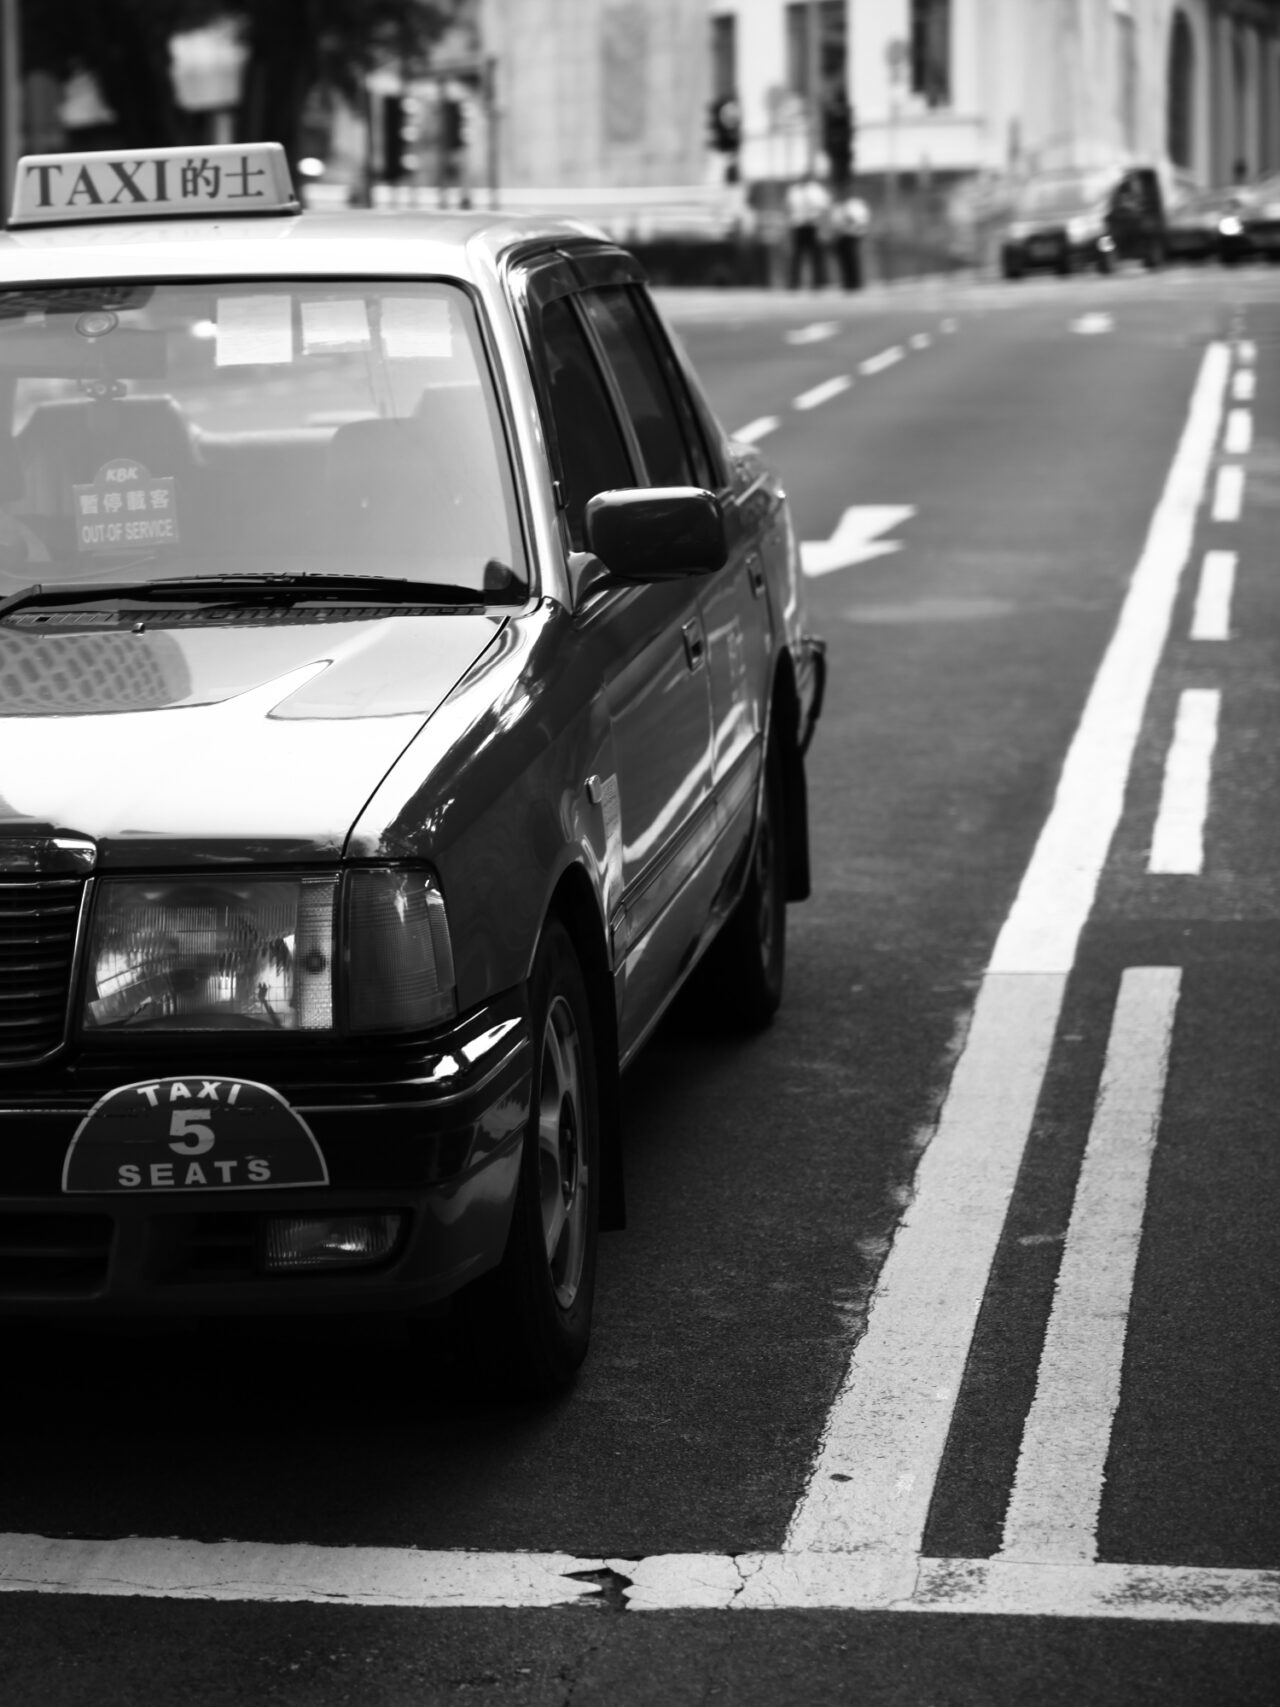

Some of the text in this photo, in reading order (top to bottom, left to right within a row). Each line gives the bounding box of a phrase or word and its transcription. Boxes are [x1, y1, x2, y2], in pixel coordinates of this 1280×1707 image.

[26, 156, 265, 207] TAXI 的士
[106, 467, 138, 482] KBK
[80, 489, 170, 514] 暫停載客
[82, 518, 173, 543] OUT OF SERVICE
[136, 1080, 241, 1107] TAXI
[168, 1108, 215, 1155] 5
[118, 1159, 271, 1186] SEATS
